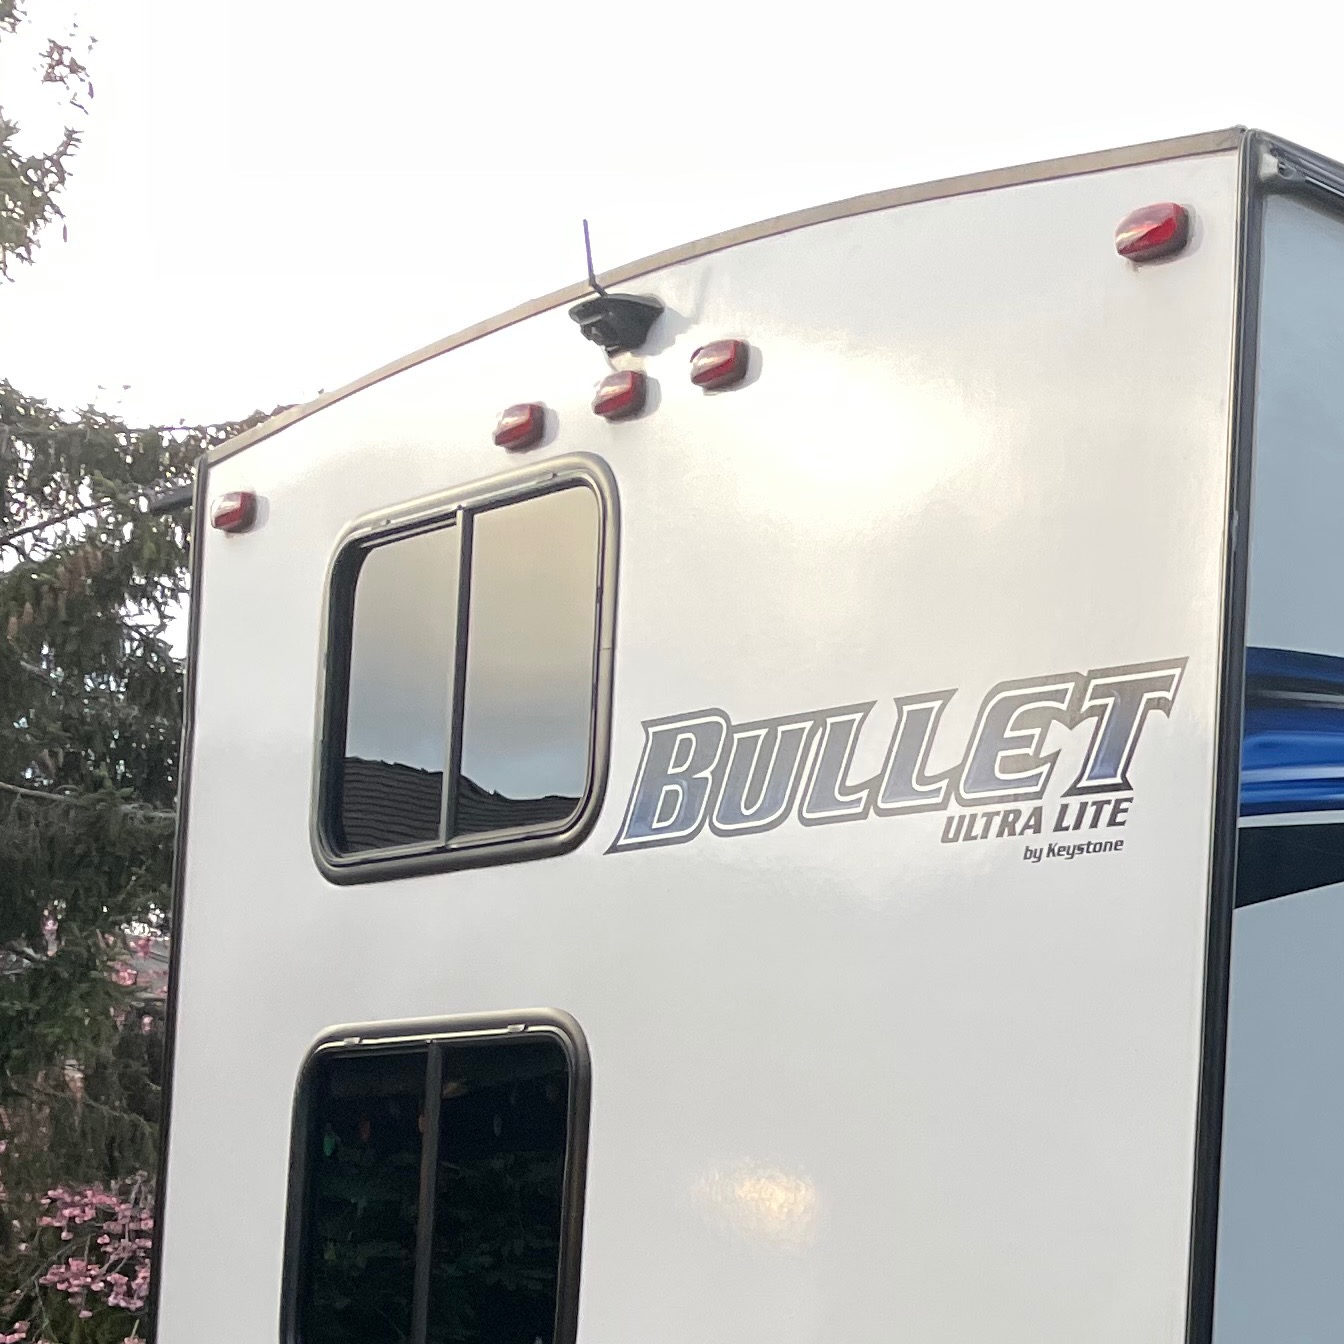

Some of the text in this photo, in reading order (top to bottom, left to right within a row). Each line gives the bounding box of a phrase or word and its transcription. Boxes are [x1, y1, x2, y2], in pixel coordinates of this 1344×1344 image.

[603, 656, 1189, 855] BULLET
[940, 797, 1135, 844] ULTRA LITE
[1023, 839, 1124, 863] by Keystone
